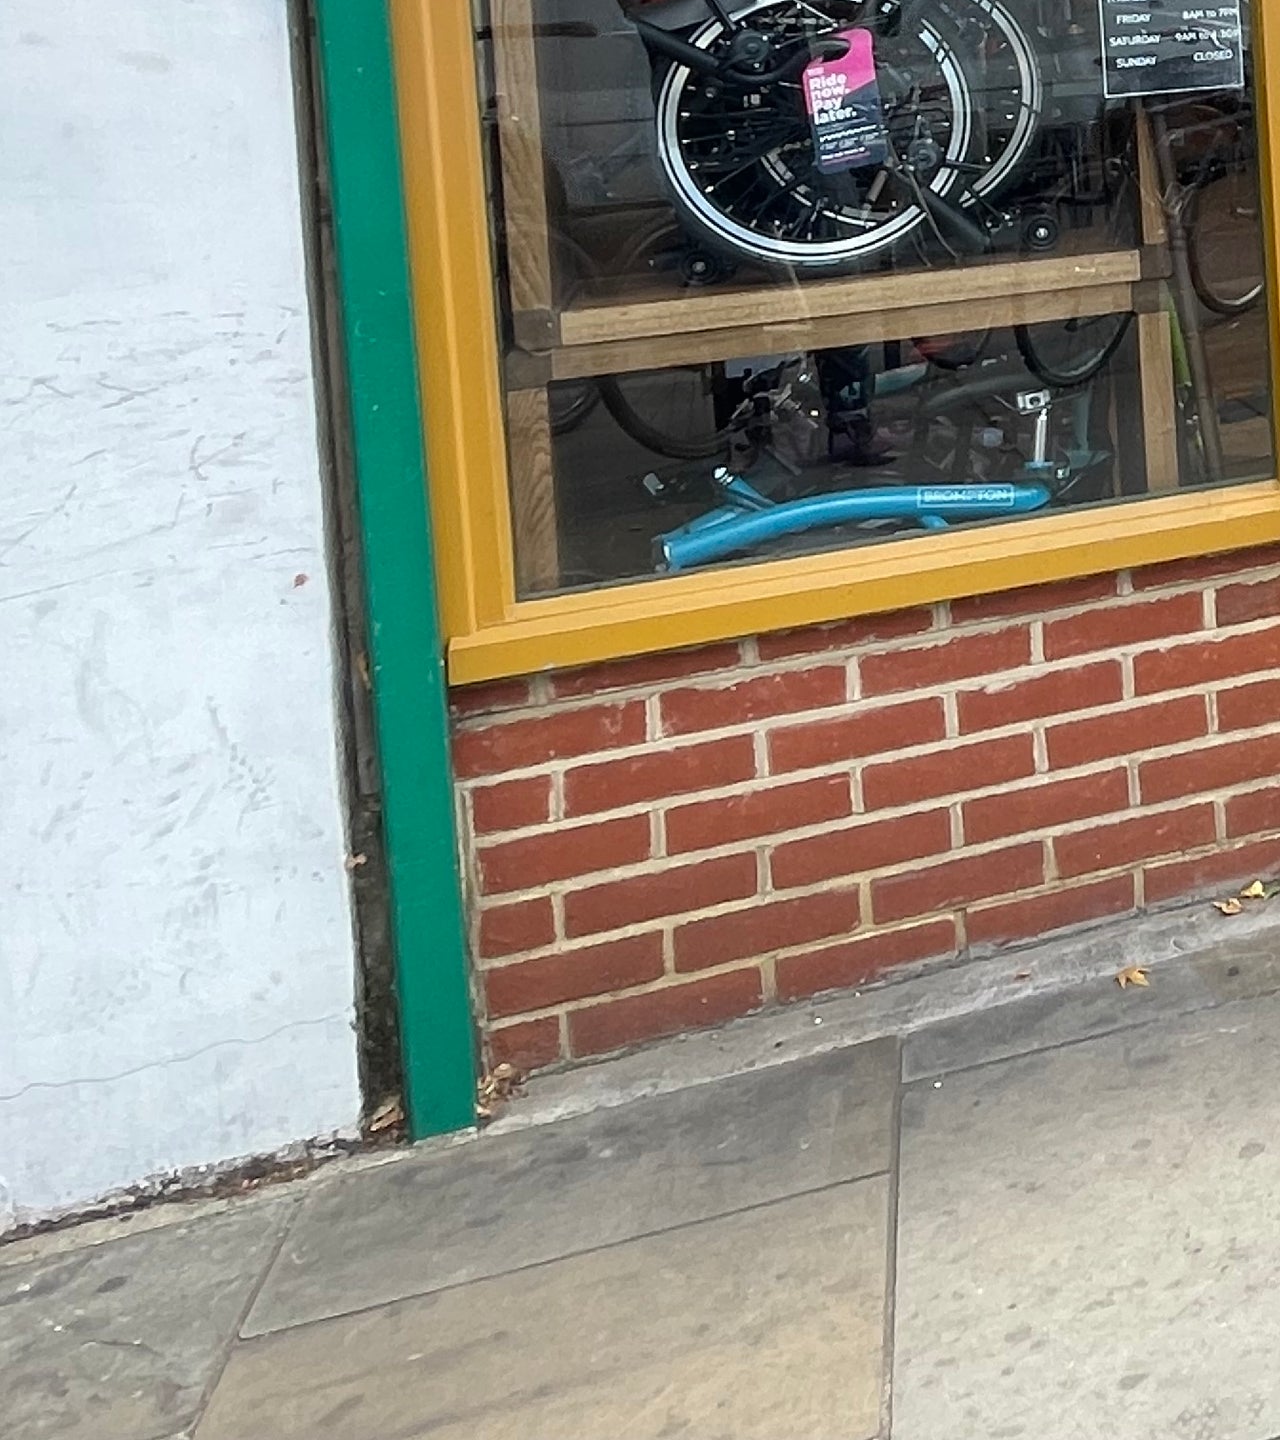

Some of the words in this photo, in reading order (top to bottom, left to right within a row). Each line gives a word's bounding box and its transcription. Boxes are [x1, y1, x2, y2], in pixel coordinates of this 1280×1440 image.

[1116, 14, 1151, 24] FRIDAY
[1109, 35, 1161, 47] SATURDAY
[1116, 56, 1157, 68] SUNDAY
[1193, 50, 1233, 61] CLOSED
[809, 73, 847, 90] Ride
[810, 85, 851, 99] now.
[814, 107, 857, 125] later.
[923, 489, 1010, 503] BROMPTON
